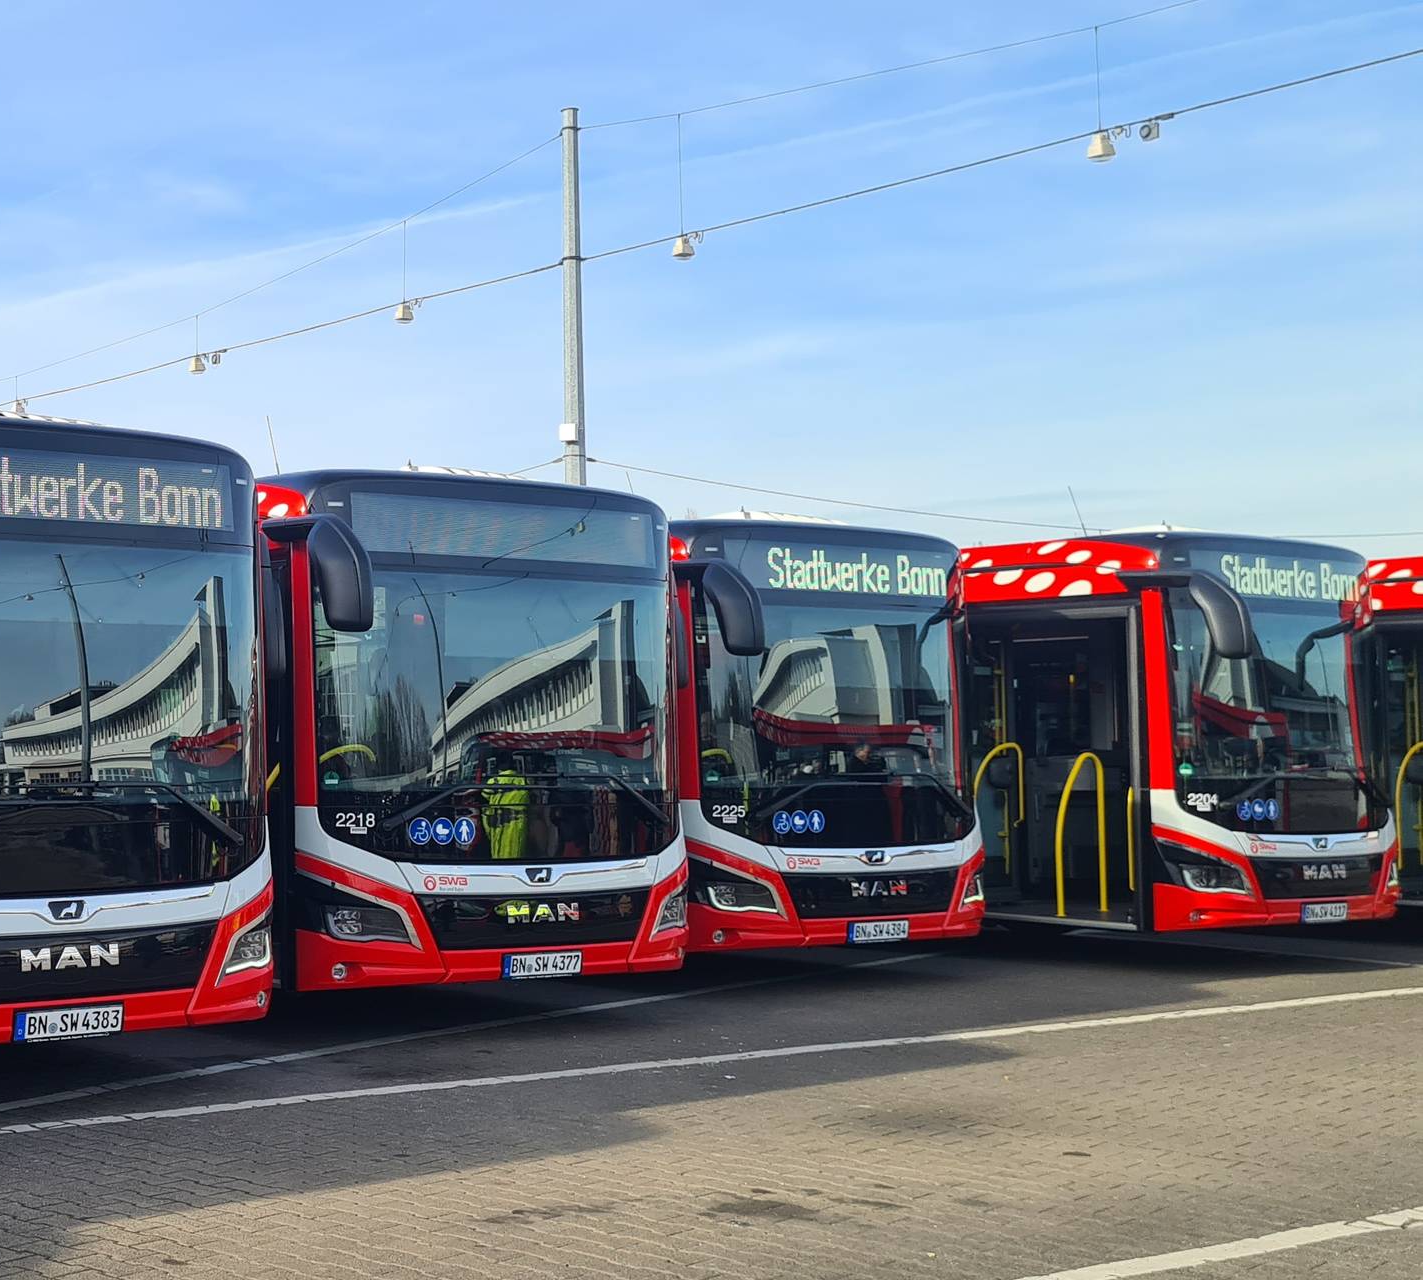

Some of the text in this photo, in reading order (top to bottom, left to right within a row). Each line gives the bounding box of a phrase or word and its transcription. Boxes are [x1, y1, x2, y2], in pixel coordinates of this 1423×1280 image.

[138, 467, 222, 528] Bonn
[767, 547, 947, 596] Stadtwerke Bonn
[1220, 554, 1360, 601] Stadtwerke Bonn
[1187, 792, 1218, 806] 2204
[335, 812, 376, 828] 2218
[712, 804, 746, 818] 2225
[1302, 863, 1347, 880] MAN
[438, 876, 468, 886] SWB
[850, 880, 908, 897] MAN
[506, 902, 580, 924] MAN
[855, 925, 867, 938] BN
[20, 943, 120, 972] MAN
[511, 957, 527, 973] BN
[552, 954, 580, 971] 4377
[27, 1009, 120, 1036] BN SW 4383
